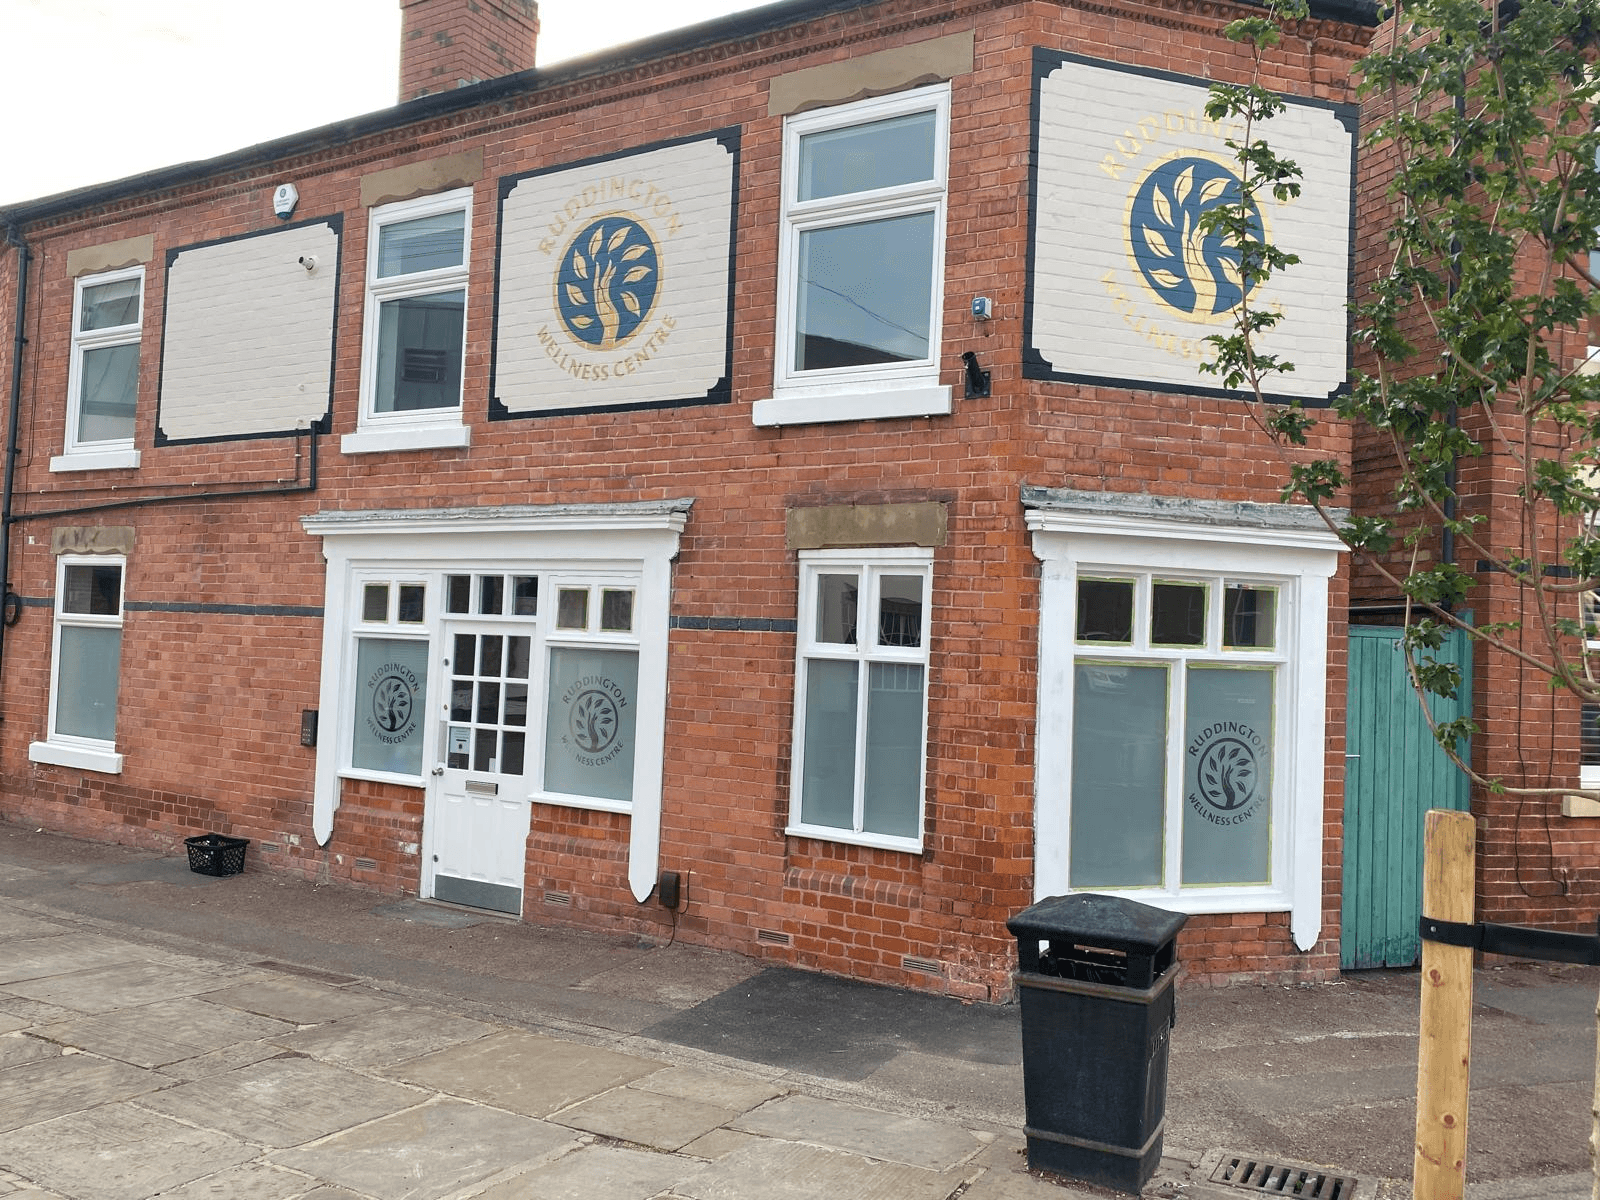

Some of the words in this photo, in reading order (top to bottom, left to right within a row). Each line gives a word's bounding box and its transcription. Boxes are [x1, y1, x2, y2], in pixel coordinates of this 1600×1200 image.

[537, 176, 683, 256] RUDDINGTON
[536, 324, 609, 381] WELLNESS
[613, 314, 677, 377] CENTRE
[367, 662, 420, 692] RUDDINGTON
[562, 675, 628, 708] RUDDINGTON
[394, 720, 417, 745] CENTRE
[1188, 721, 1270, 758] RUDDINGTON
[595, 739, 625, 766] CENTRE
[1188, 792, 1231, 826] WELLNESS
[1232, 793, 1266, 825] CENTRE
